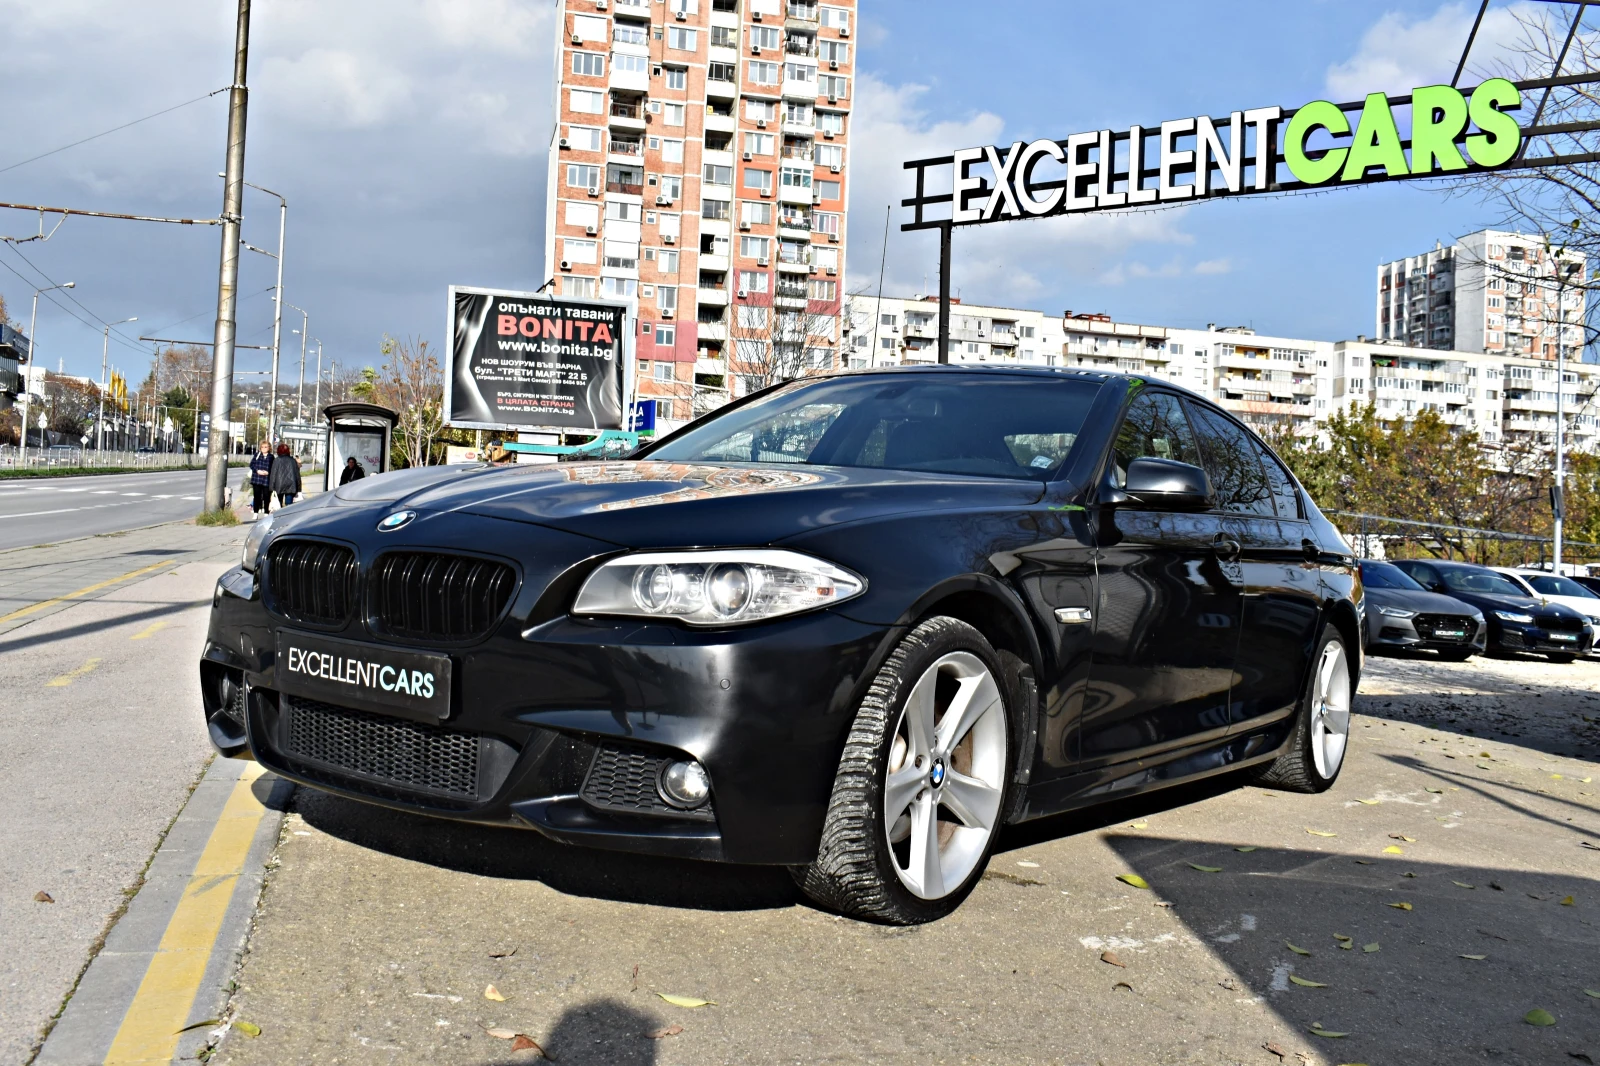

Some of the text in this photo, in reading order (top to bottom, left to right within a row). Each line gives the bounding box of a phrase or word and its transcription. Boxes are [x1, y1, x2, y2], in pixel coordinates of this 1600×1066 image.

[498, 302, 614, 321] опънати тавани
[497, 340, 613, 361] www.bonita.bg
[500, 359, 535, 368] ШОУРУМ
[536, 361, 554, 369] ВЪВ
[555, 362, 582, 371] ВАРНА
[474, 366, 495, 375] бул.
[568, 372, 579, 380] 22
[505, 398, 539, 406] ЦЯЛАТА
[540, 400, 575, 408] СТРАНА!
[497, 405, 575, 416] www.BONITA.bg
[288, 646, 435, 699] EXCELLENTCARS
